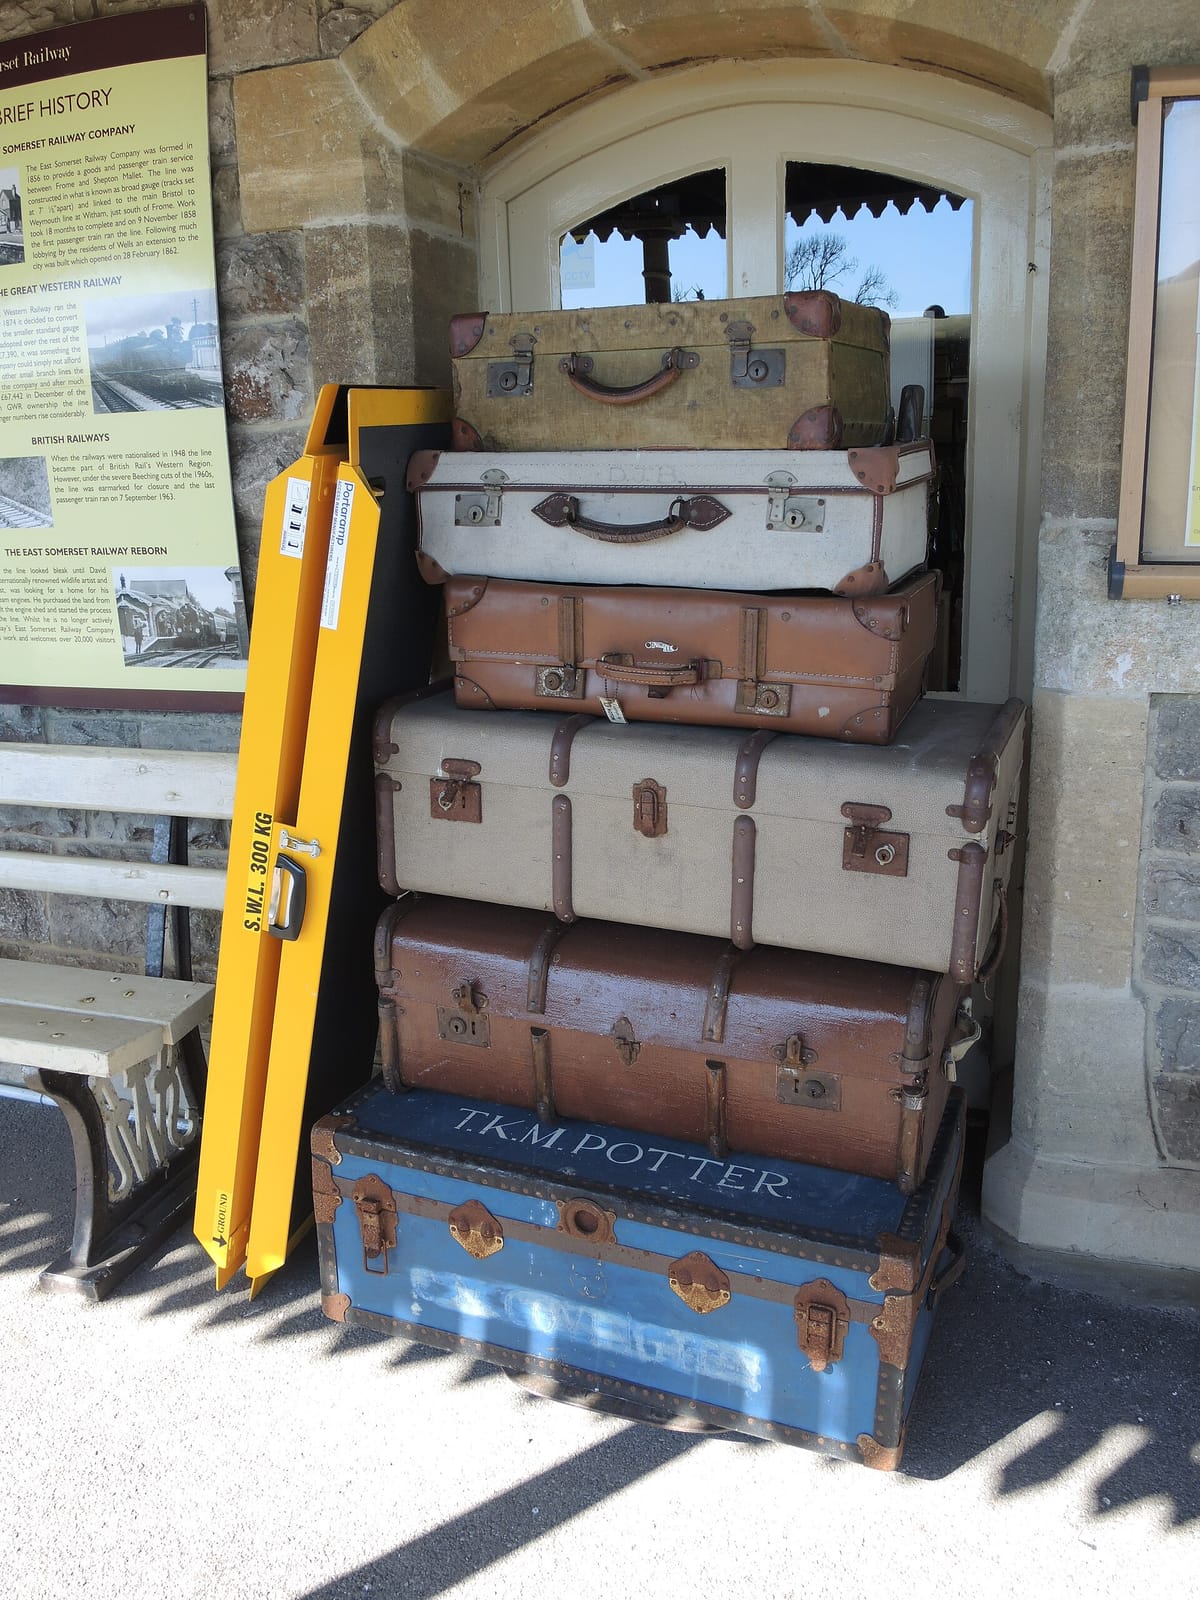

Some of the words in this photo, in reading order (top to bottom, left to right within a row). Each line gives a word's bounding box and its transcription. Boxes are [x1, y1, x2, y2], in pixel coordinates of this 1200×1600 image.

[24, 46, 71, 66] Railway
[40, 87, 112, 117] HISTORY
[2, 138, 46, 154] SOMERSET
[48, 132, 85, 146] RAILWAY
[88, 124, 135, 140] COMPANY
[39, 161, 52, 170] East
[54, 157, 82, 168] Somerset
[84, 154, 107, 166] Railway
[110, 149, 140, 162] Company
[159, 143, 184, 153] formed
[27, 174, 41, 183] 1856
[52, 169, 74, 181] provide
[83, 166, 101, 177] goods
[118, 161, 149, 172] passenger
[152, 157, 168, 166] train
[170, 153, 194, 164] service
[27, 183, 52, 194] between
[55, 180, 75, 190] Frome
[78, 178, 90, 187] and
[93, 174, 118, 187] Shepton
[149, 169, 161, 177] The
[164, 166, 177, 175] line
[27, 193, 62, 205] constructed
[91, 186, 112, 196] known
[121, 183, 140, 193] broad
[141, 182, 160, 192] gauge
[161, 177, 183, 189] (tracks
[93, 198, 112, 208] linked
[162, 189, 183, 199] Bristol
[29, 215, 61, 228] Weymouth
[62, 214, 73, 222] line
[110, 208, 122, 218] just
[123, 205, 141, 215] south
[177, 199, 197, 208] Work
[53, 225, 76, 234] months
[85, 220, 113, 233] complete
[143, 213, 178, 224] November
[181, 211, 198, 220] 1858
[42, 238, 54, 247] first
[56, 236, 85, 247] passenger
[87, 233, 102, 242] train
[146, 224, 177, 237] Following
[32, 249, 57, 260] lobbying
[79, 243, 107, 253] residents
[117, 240, 134, 249] Wells
[145, 235, 176, 246] extension
[56, 258, 70, 267] built
[70, 256, 88, 266] which
[89, 254, 112, 265] opened
[132, 249, 160, 261] February
[10, 284, 37, 296] GREAT
[40, 280, 81, 292] WESTERN
[83, 275, 122, 288] RAILWAY
[31, 435, 64, 445] BRITISH
[66, 432, 110, 443] RAILWAYS
[50, 453, 69, 461] When
[81, 452, 105, 462] railways
[125, 450, 160, 459] nationalised
[52, 464, 76, 472] became
[80, 463, 94, 473] part
[109, 462, 130, 470] British
[134, 461, 151, 469] Rail's
[156, 460, 184, 469] Western
[98, 483, 130, 491] earmarked
[147, 482, 170, 490] closure
[132, 472, 160, 482] Beeching
[56, 496, 84, 504] passenger
[124, 493, 157, 503] September
[336, 482, 354, 546] Portaramp
[23, 586, 44, 595] looking
[42, 596, 71, 605] purchased
[14, 605, 32, 614] engine
[60, 625, 82, 634] Railway
[86, 625, 114, 634] Company
[70, 616, 88, 624] longer
[91, 616, 113, 625] actively
[254, 812, 272, 836] KG
[251, 840, 269, 875] 300
[217, 1194, 227, 1233] GROUND
